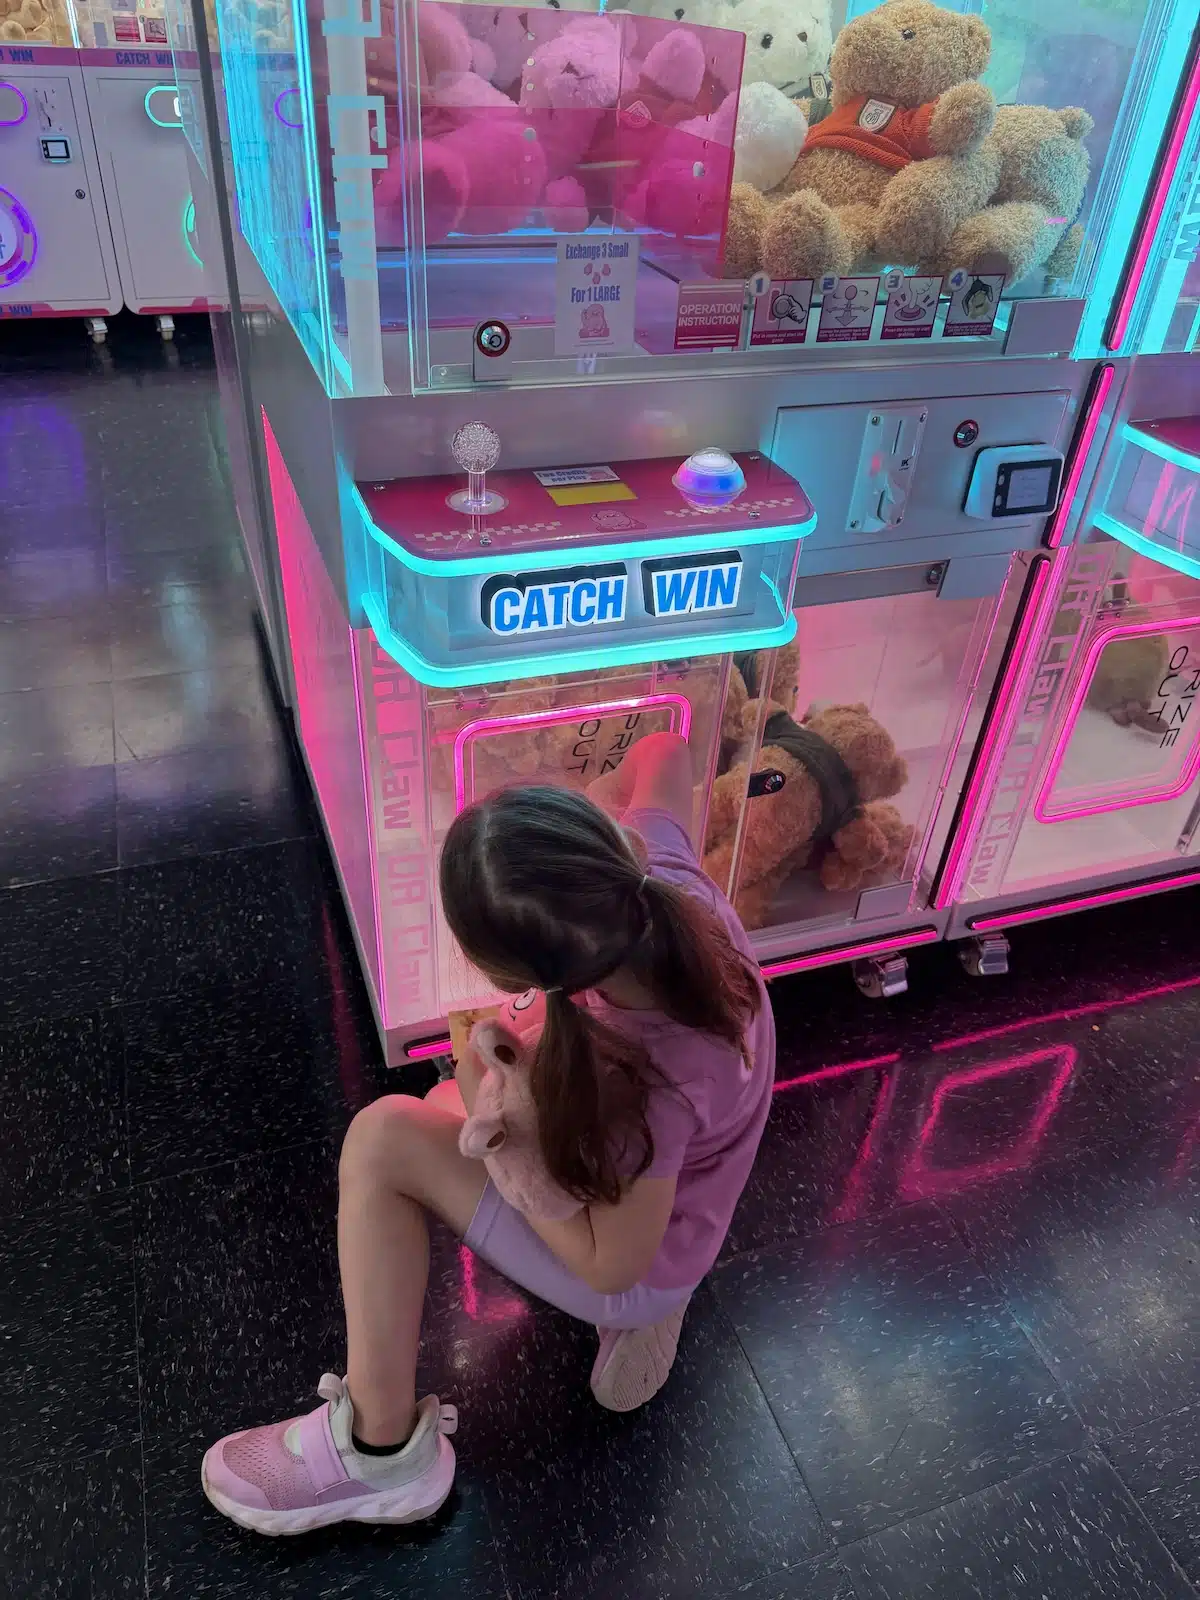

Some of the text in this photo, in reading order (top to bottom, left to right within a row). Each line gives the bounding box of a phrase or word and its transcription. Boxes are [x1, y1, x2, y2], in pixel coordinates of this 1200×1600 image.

[115, 52, 150, 65] CATCH
[565, 242, 629, 260] Exchange 3 Small
[755, 278, 764, 293] 1
[823, 277, 835, 290] 2
[887, 275, 899, 288] 3
[949, 272, 963, 287] 4
[571, 285, 621, 303] For 1 LARGE
[679, 303, 741, 315] OPERATION
[678, 314, 740, 327] INSTRUCTION
[492, 565, 741, 635] CATCH WIN
[1148, 645, 1189, 722] OUT
[1160, 668, 1200, 749] RIZE
[566, 719, 600, 773] OUT
[600, 713, 640, 773] PRIZ
